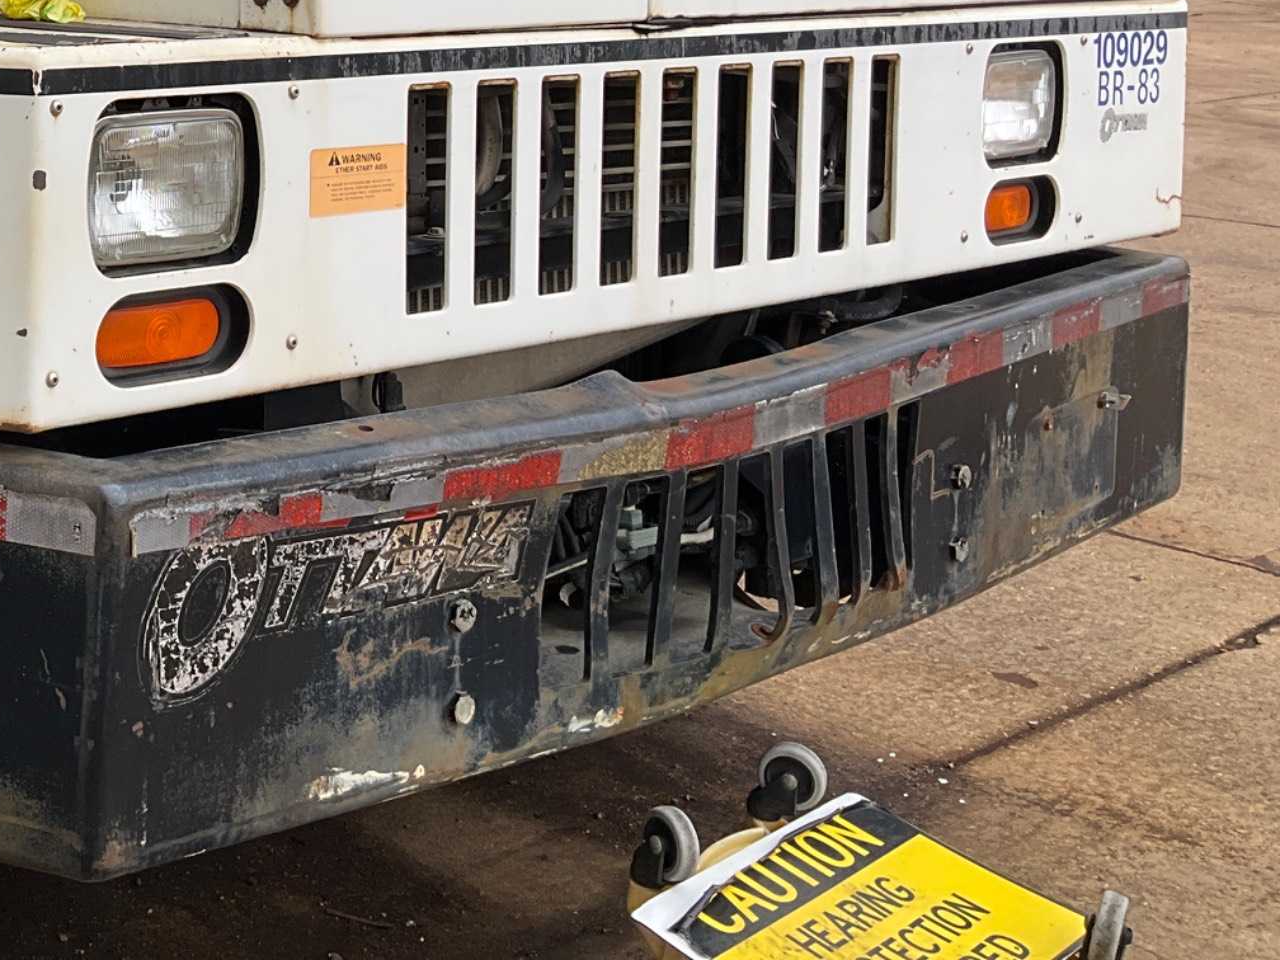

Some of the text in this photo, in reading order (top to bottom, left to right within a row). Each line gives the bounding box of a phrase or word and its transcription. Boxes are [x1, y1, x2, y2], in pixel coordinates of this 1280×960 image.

[1093, 29, 1168, 69] 109029
[1097, 67, 1160, 107] BR-83
[341, 152, 382, 164] WARNING
[697, 814, 886, 935] CAUTION
[785, 875, 916, 959] HEARING
